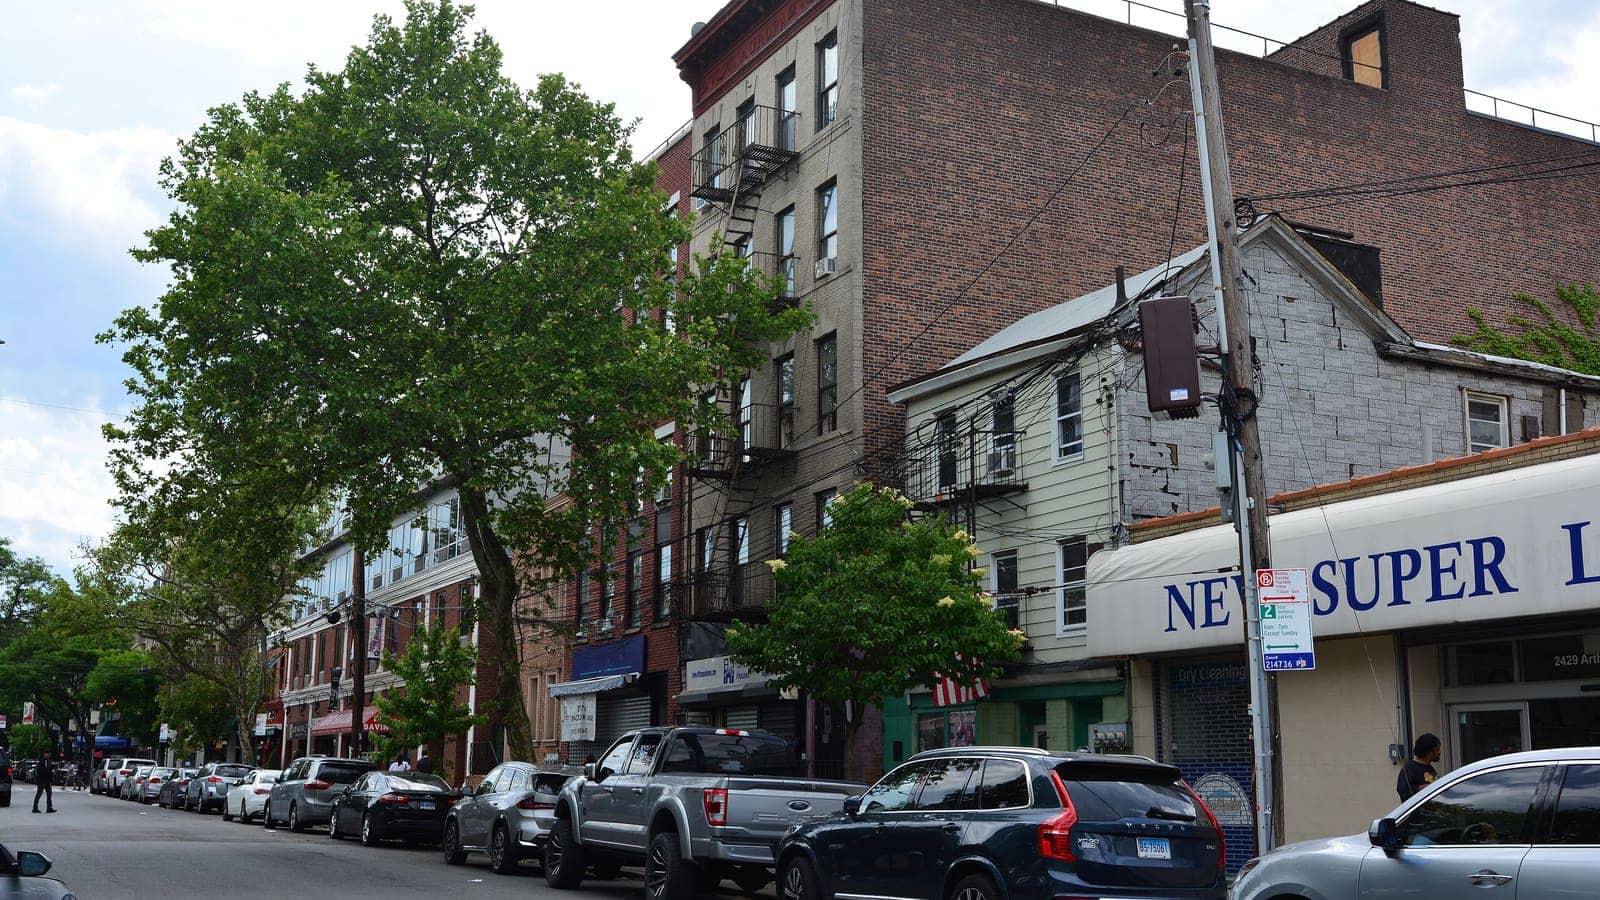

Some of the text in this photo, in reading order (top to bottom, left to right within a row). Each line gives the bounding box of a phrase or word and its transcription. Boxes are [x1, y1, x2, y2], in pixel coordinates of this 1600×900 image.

[1163, 574, 1243, 633] NE
[1312, 535, 1520, 616] SUPER
[1264, 605, 1273, 618] 2
[1265, 660, 1293, 669] 214736
[1554, 654, 1579, 666] 2429
[1179, 664, 1246, 684] Dry Cleaning
